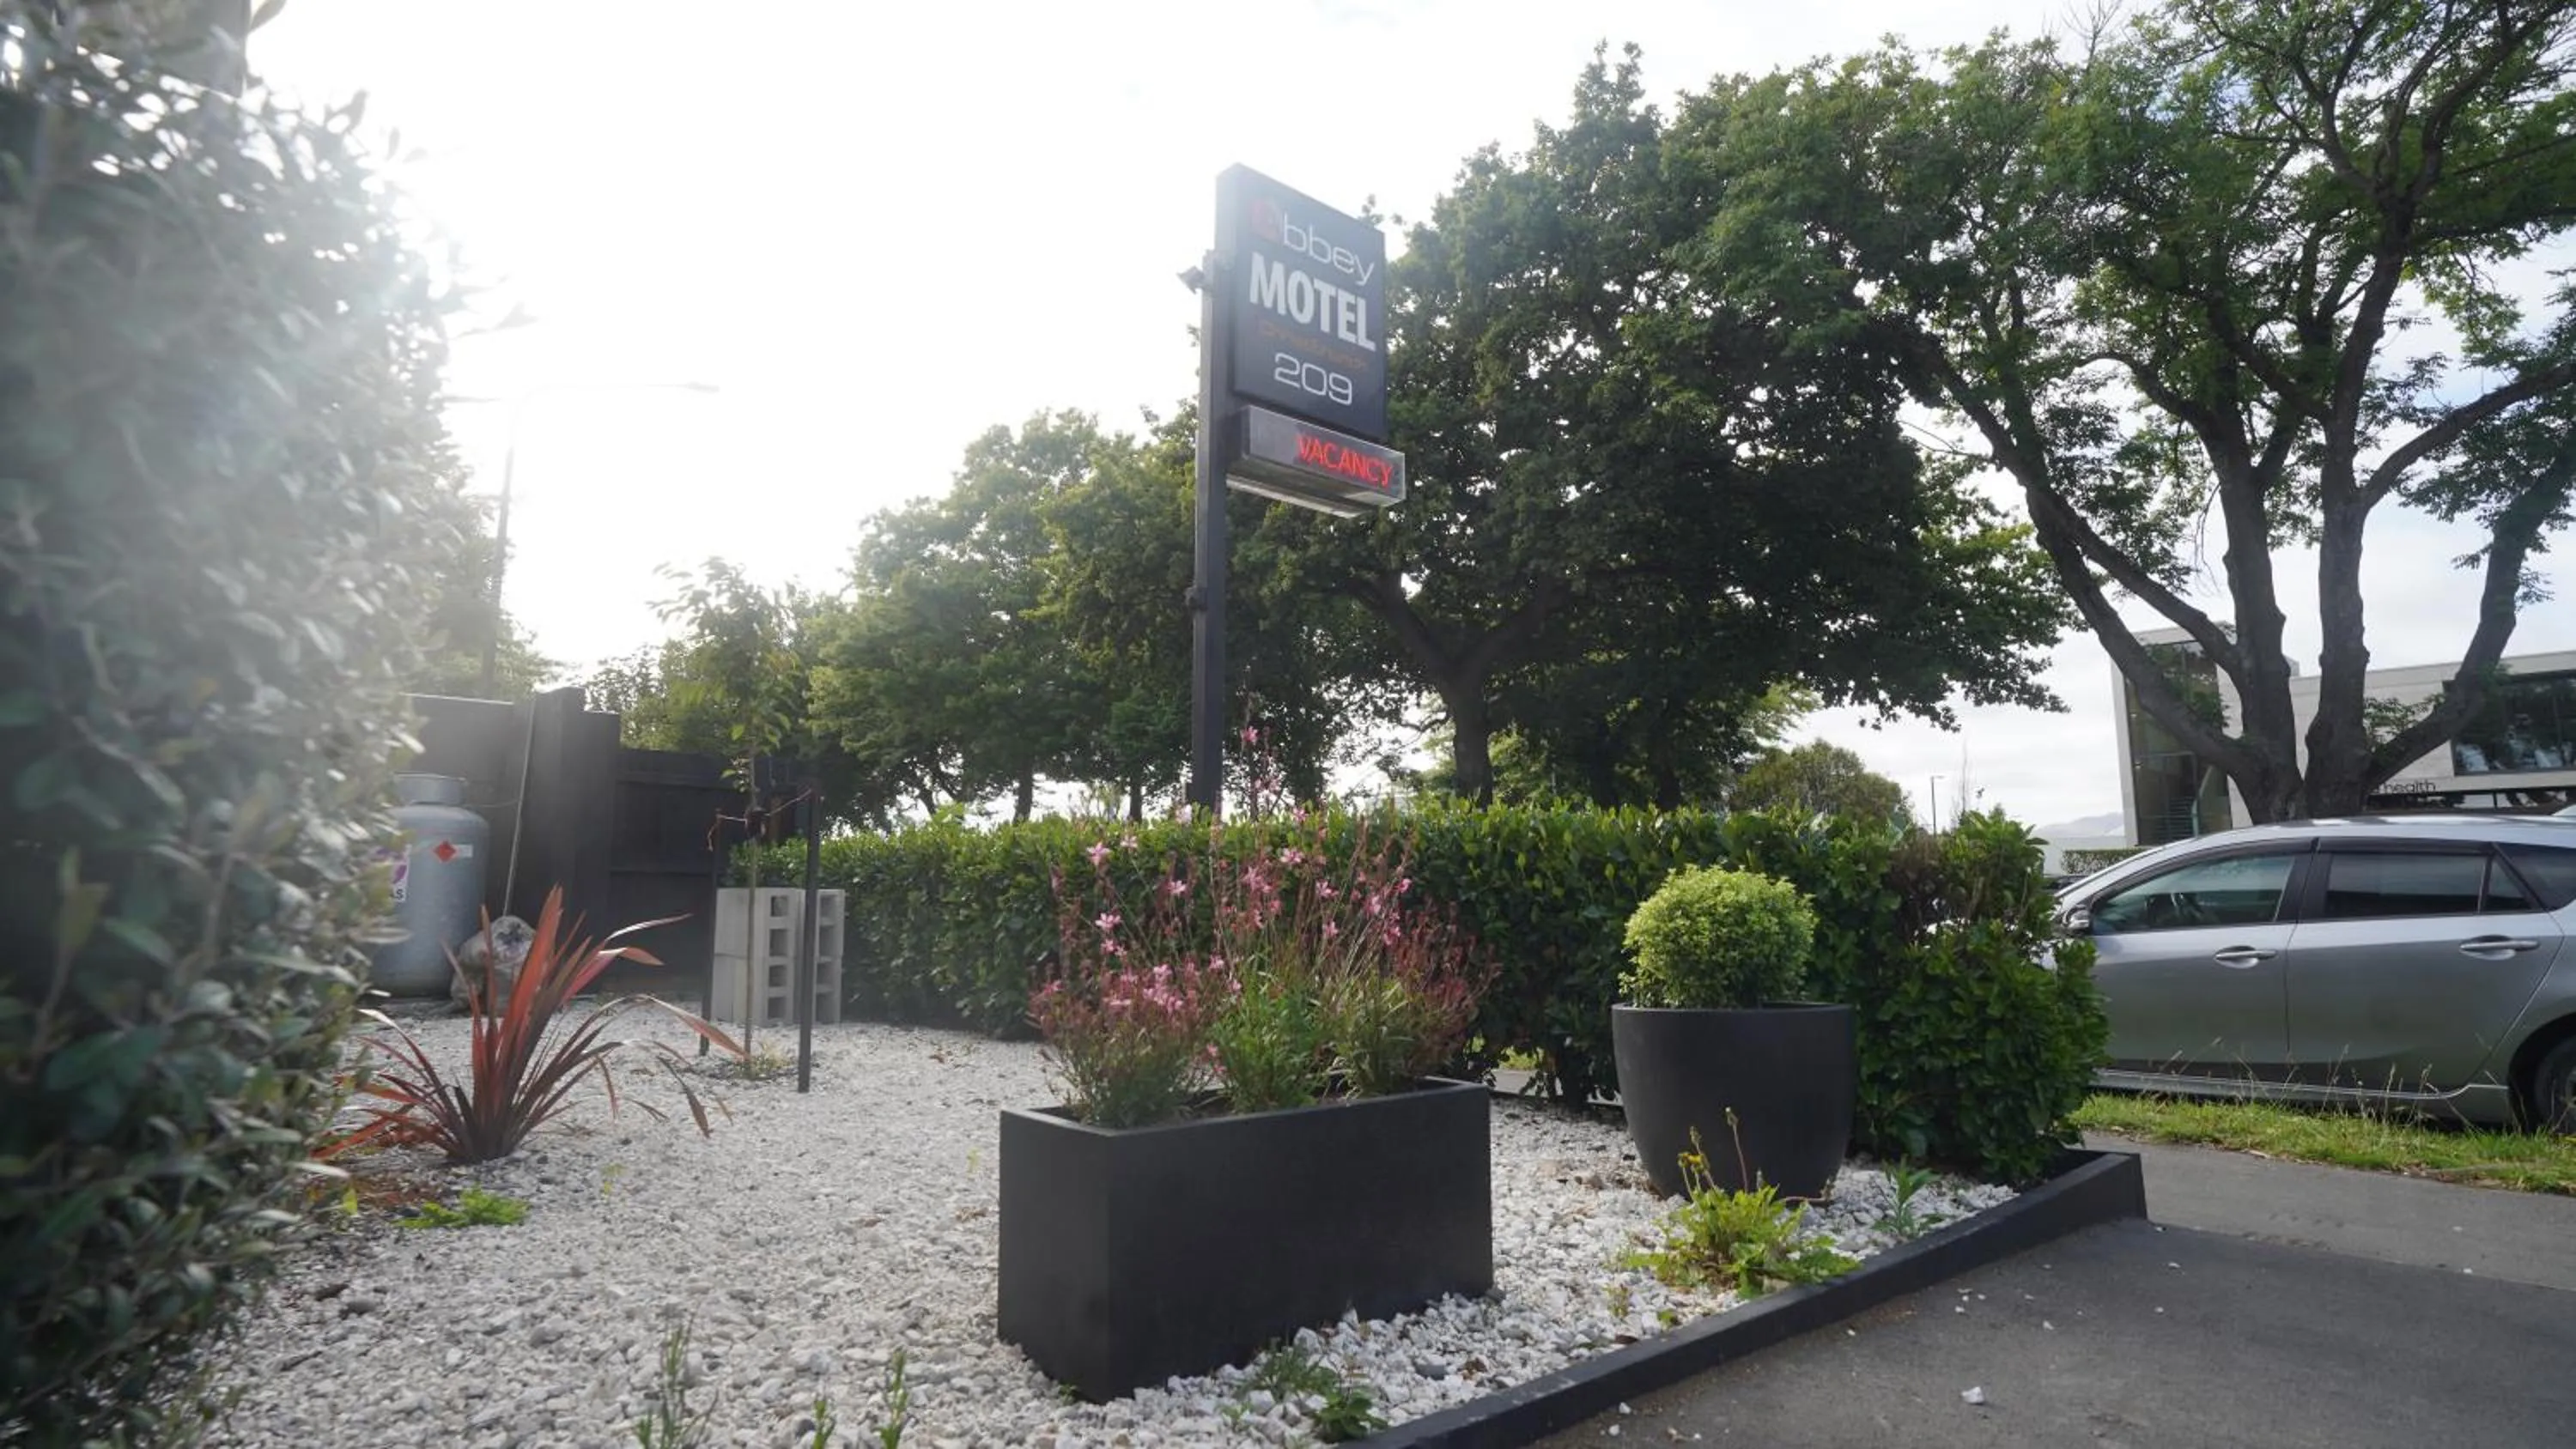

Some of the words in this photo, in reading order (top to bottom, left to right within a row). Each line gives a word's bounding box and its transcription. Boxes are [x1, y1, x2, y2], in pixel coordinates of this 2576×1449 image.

[1249, 251, 1376, 352] MOTEL
[1274, 353, 1352, 405] 209
[1297, 434, 1392, 488] VACANCY
